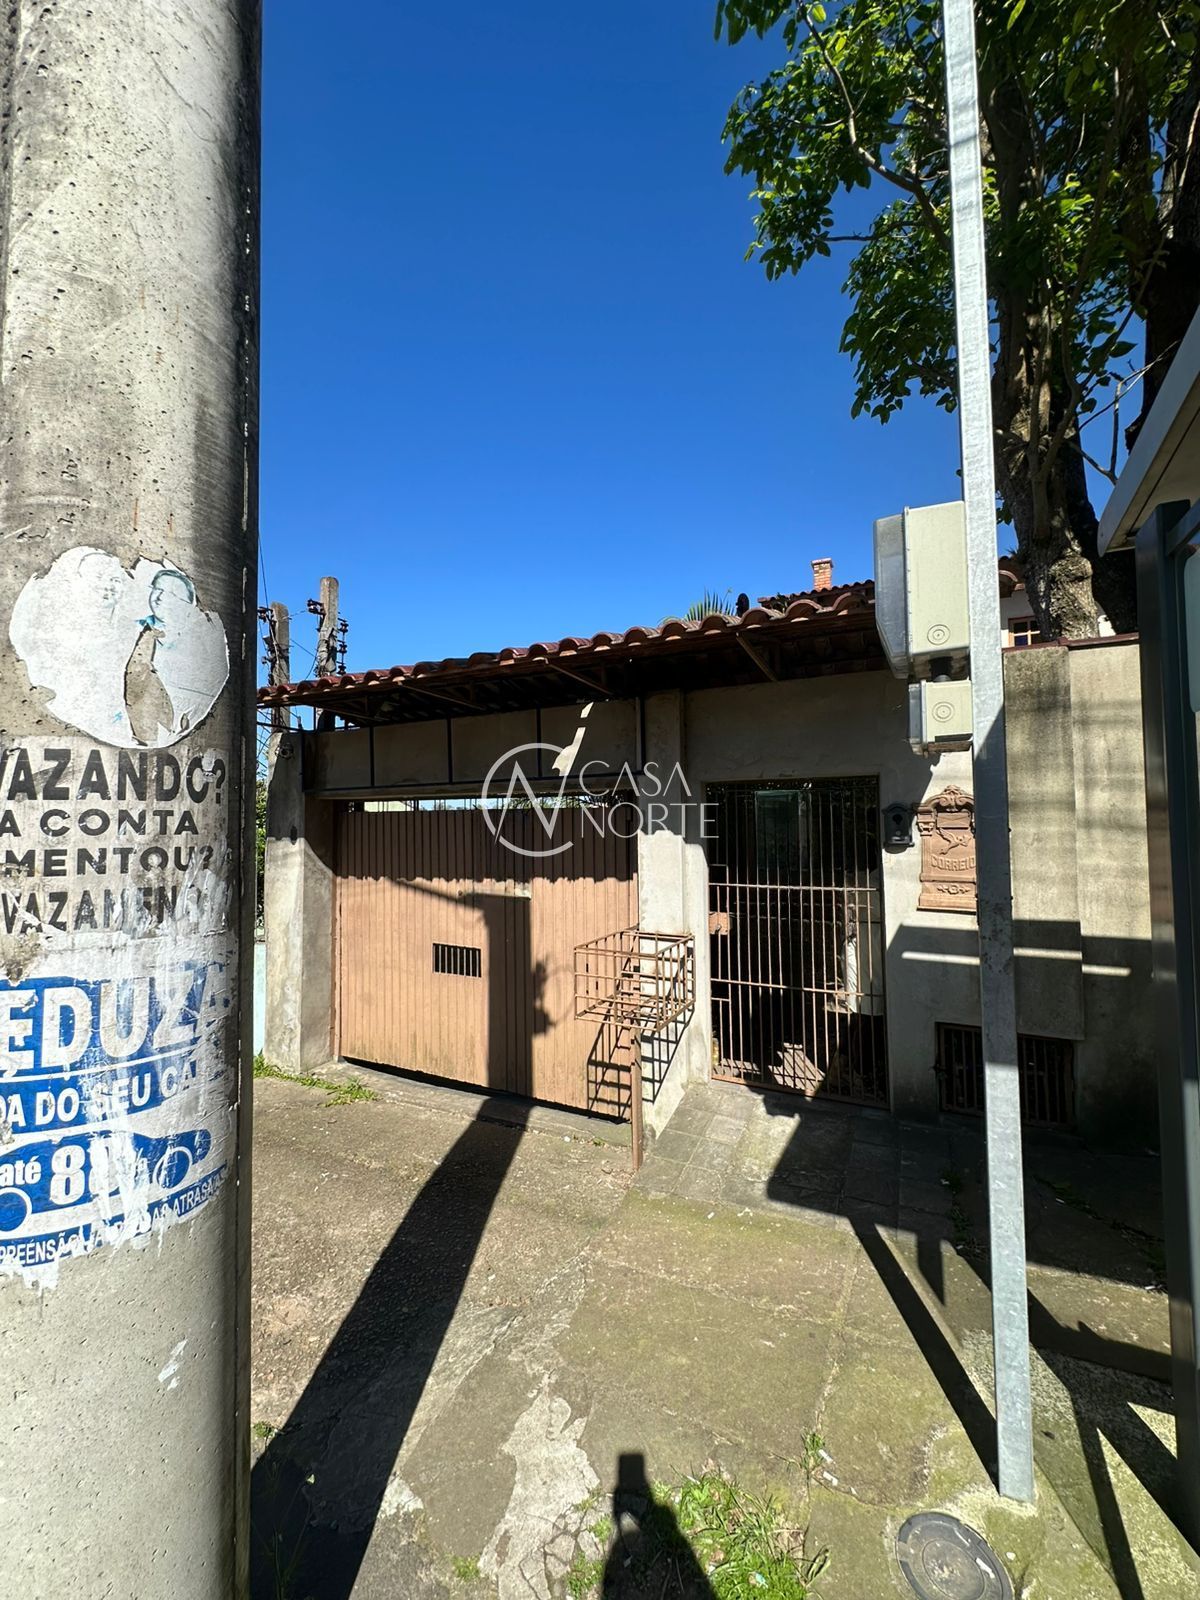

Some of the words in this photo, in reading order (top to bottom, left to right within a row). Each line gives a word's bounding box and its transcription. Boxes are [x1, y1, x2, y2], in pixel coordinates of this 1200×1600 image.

[40, 809, 199, 837] CONTA
[931, 854, 976, 871] CORREIO
[35, 1088, 80, 1126] DO
[0, 1155, 42, 1187] até
